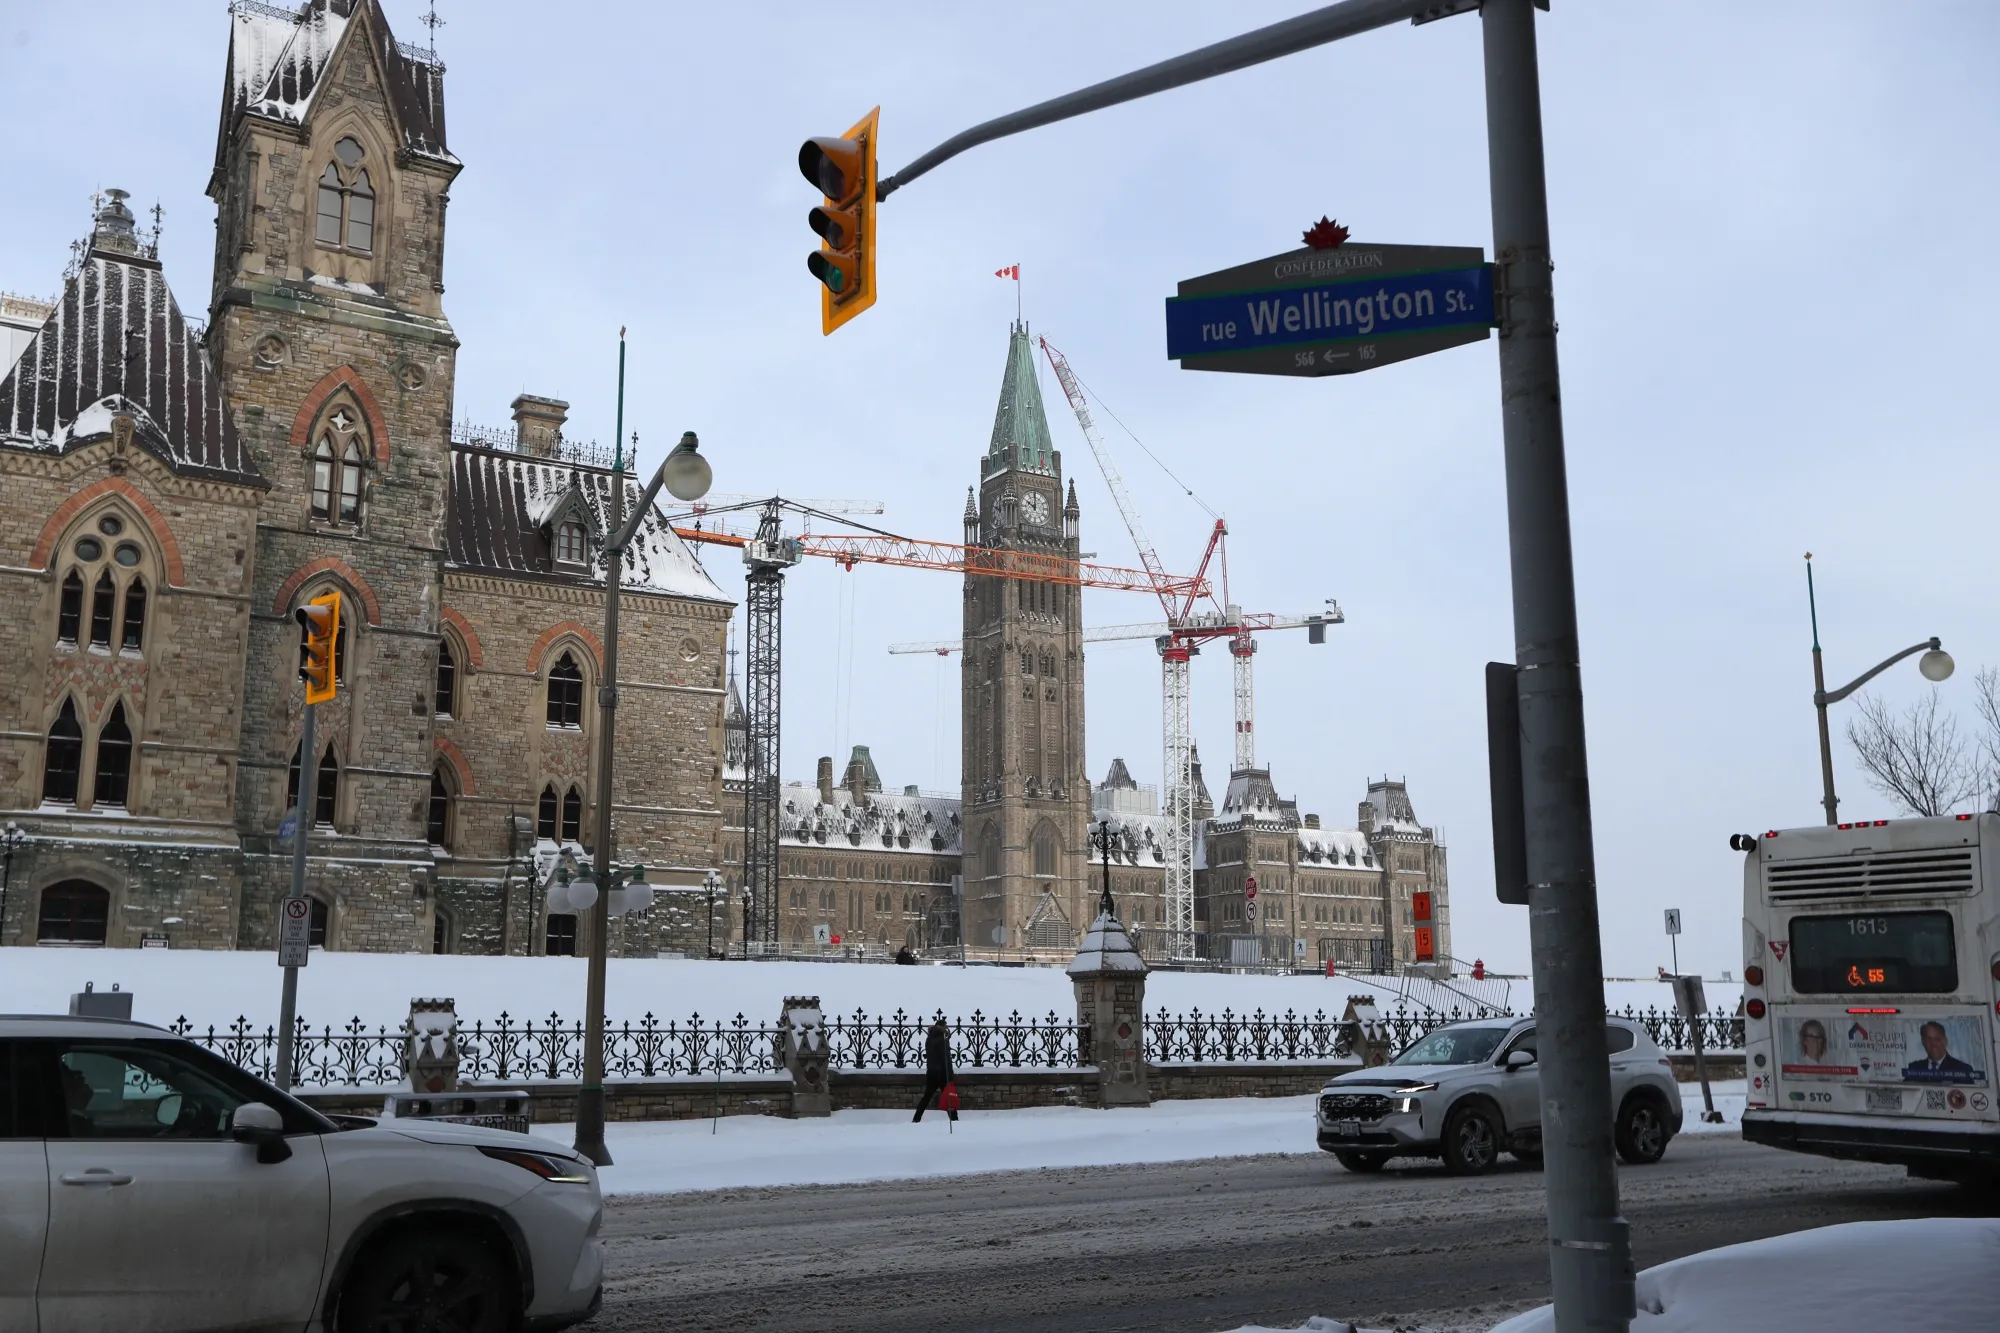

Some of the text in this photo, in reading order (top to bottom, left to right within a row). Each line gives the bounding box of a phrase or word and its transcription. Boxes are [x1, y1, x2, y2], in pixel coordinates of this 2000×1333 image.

[1275, 252, 1382, 279] CONFEDERATION
[1203, 288, 1474, 341] rue Wellington St.
[1295, 344, 1376, 367] 566 165
[1848, 918, 1888, 935] 1613
[1419, 933, 1429, 946] 15
[1868, 968, 1885, 983] 55
[1809, 1092, 1832, 1102] STO
